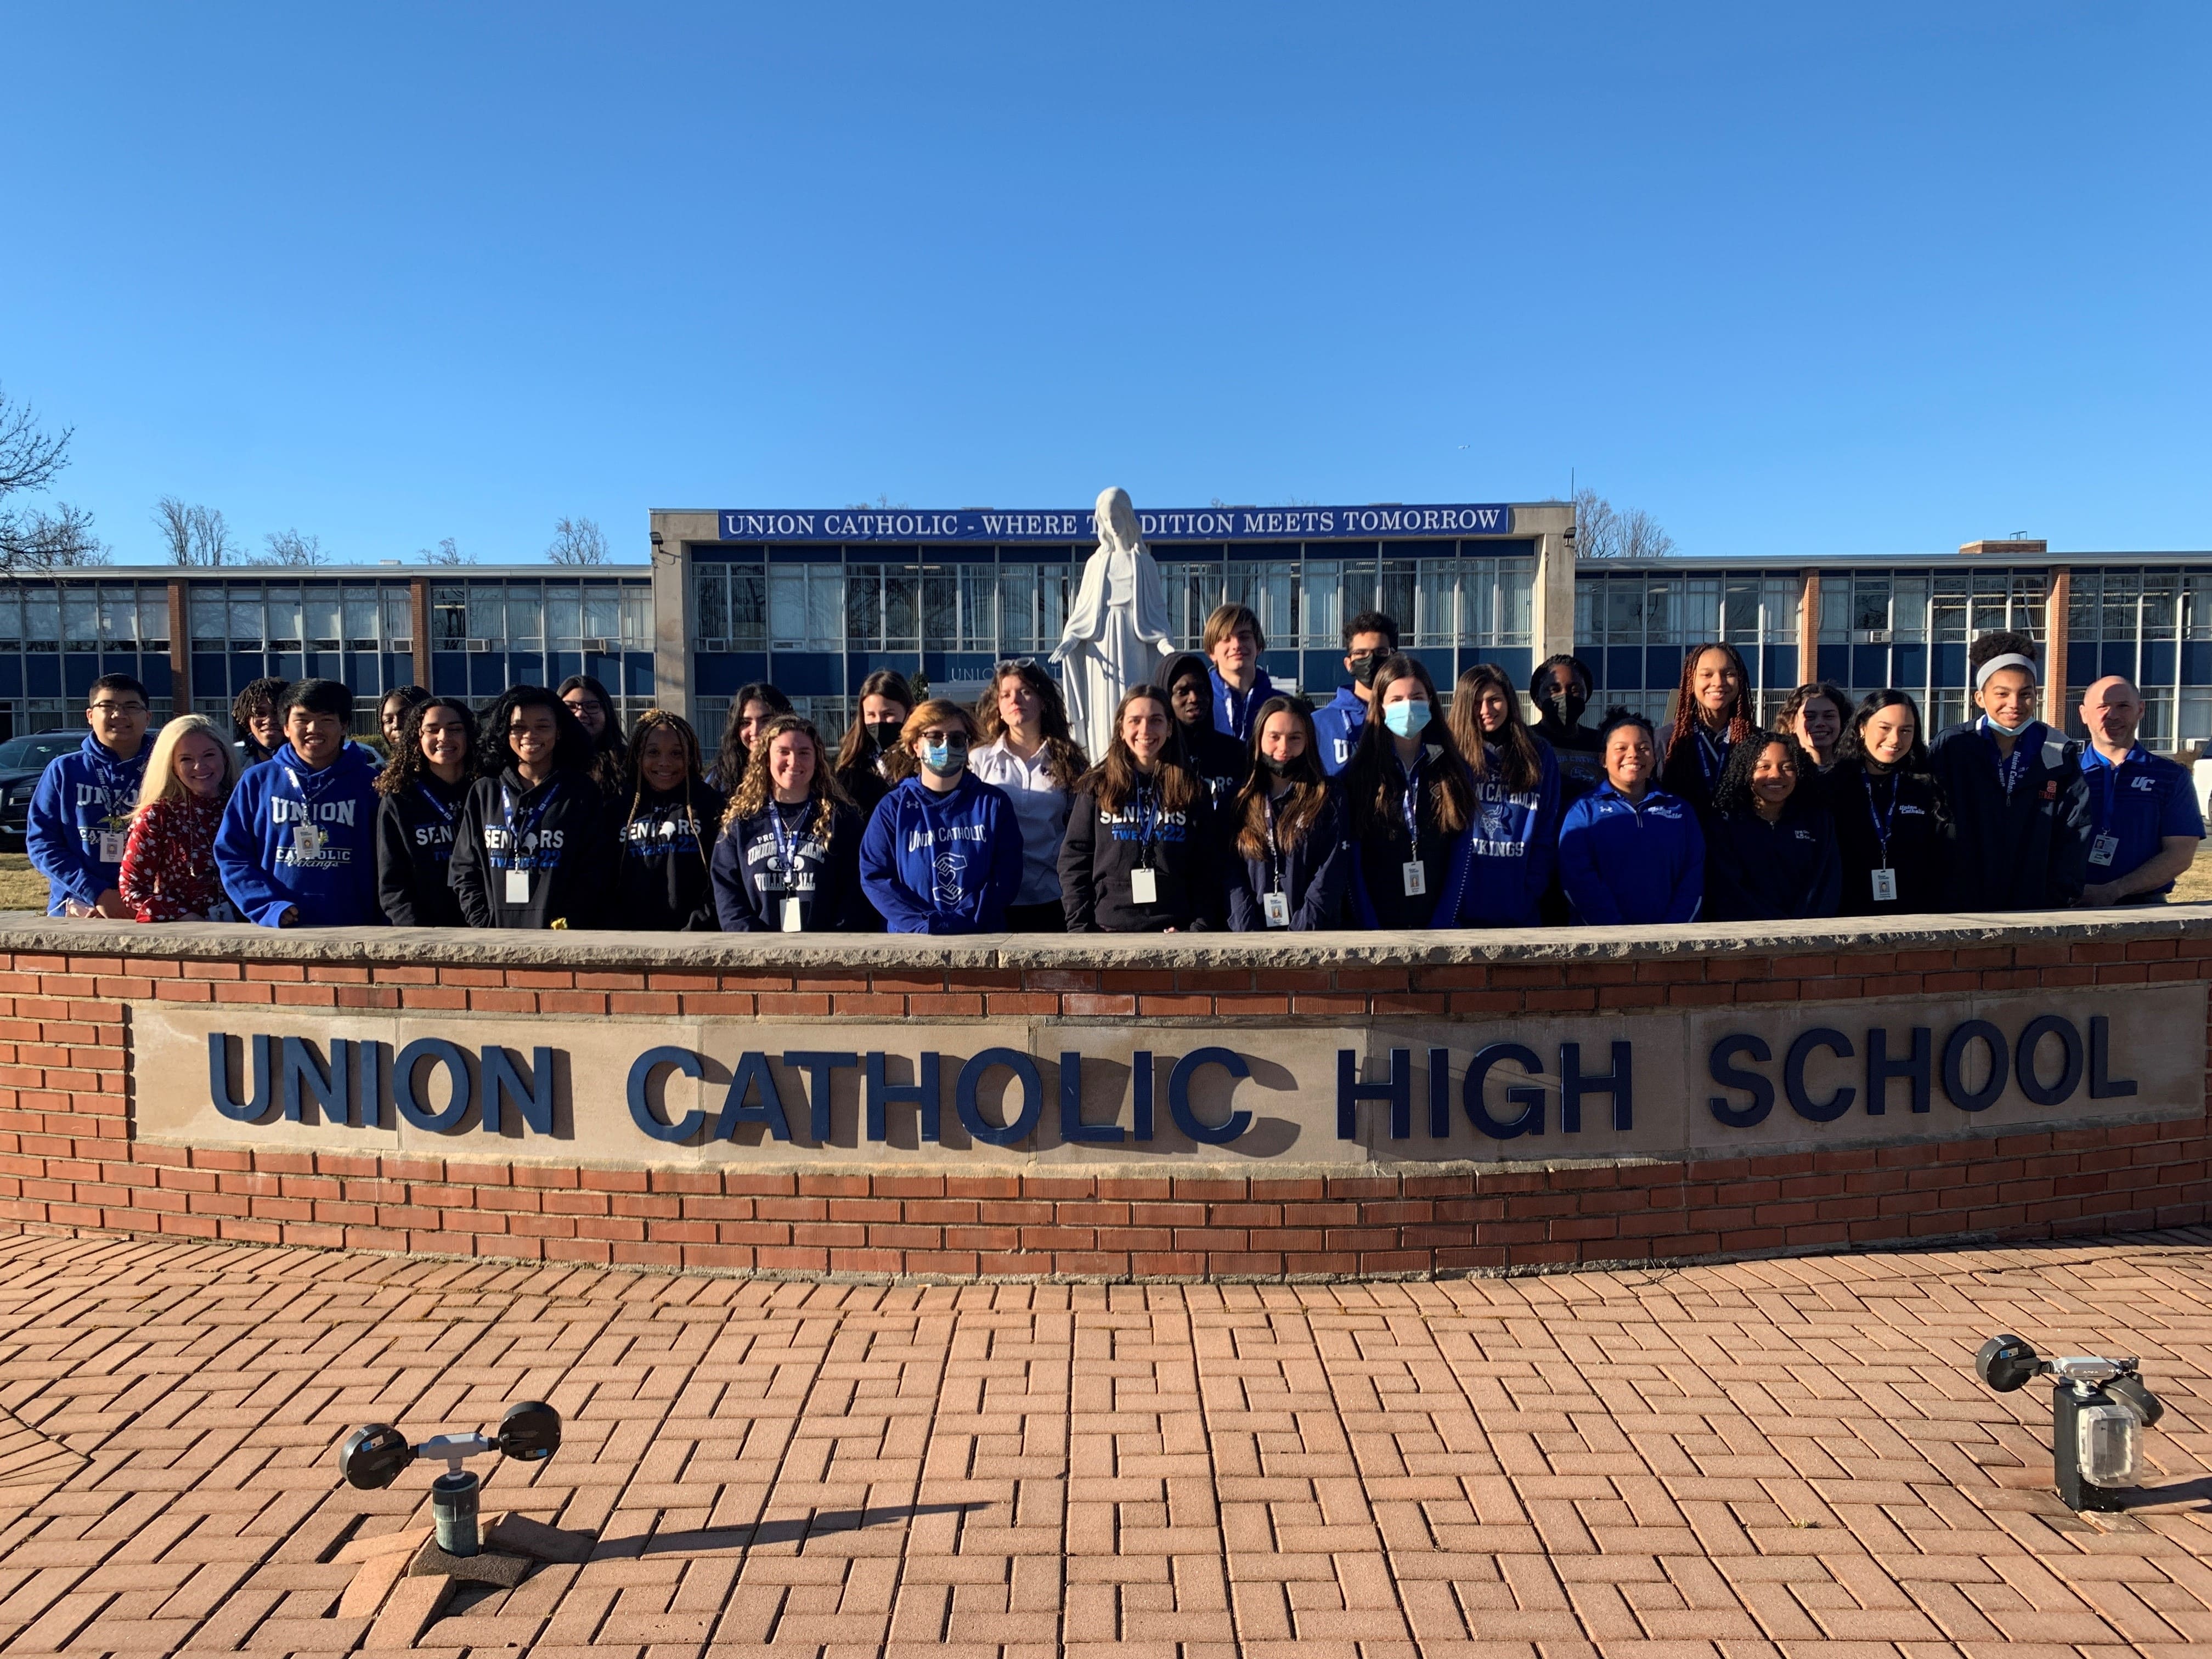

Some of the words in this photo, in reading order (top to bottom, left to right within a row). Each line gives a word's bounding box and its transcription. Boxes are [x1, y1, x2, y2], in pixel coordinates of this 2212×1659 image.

[727, 515, 815, 535] UNION
[824, 514, 958, 535] CATHOLIC
[981, 514, 1077, 535] WHERE
[1086, 513, 1234, 534] TDITION
[1243, 511, 1334, 533] MEETS
[1342, 509, 1500, 532] TOMORROW
[2011, 751, 2022, 770] Union
[2131, 776, 2155, 791] UC
[271, 795, 356, 827] UNION
[909, 830, 935, 853] UNION
[939, 824, 987, 843] CATHOLIC
[1164, 824, 1186, 842] 22
[276, 849, 351, 861] CAOLIC
[1472, 838, 1525, 857] IKINGS
[208, 1032, 553, 1135] UNION
[626, 1045, 1253, 1145] CATHOLIC
[1336, 1040, 1633, 1140] HIGH
[1709, 1014, 2138, 1128] SCHOOL
